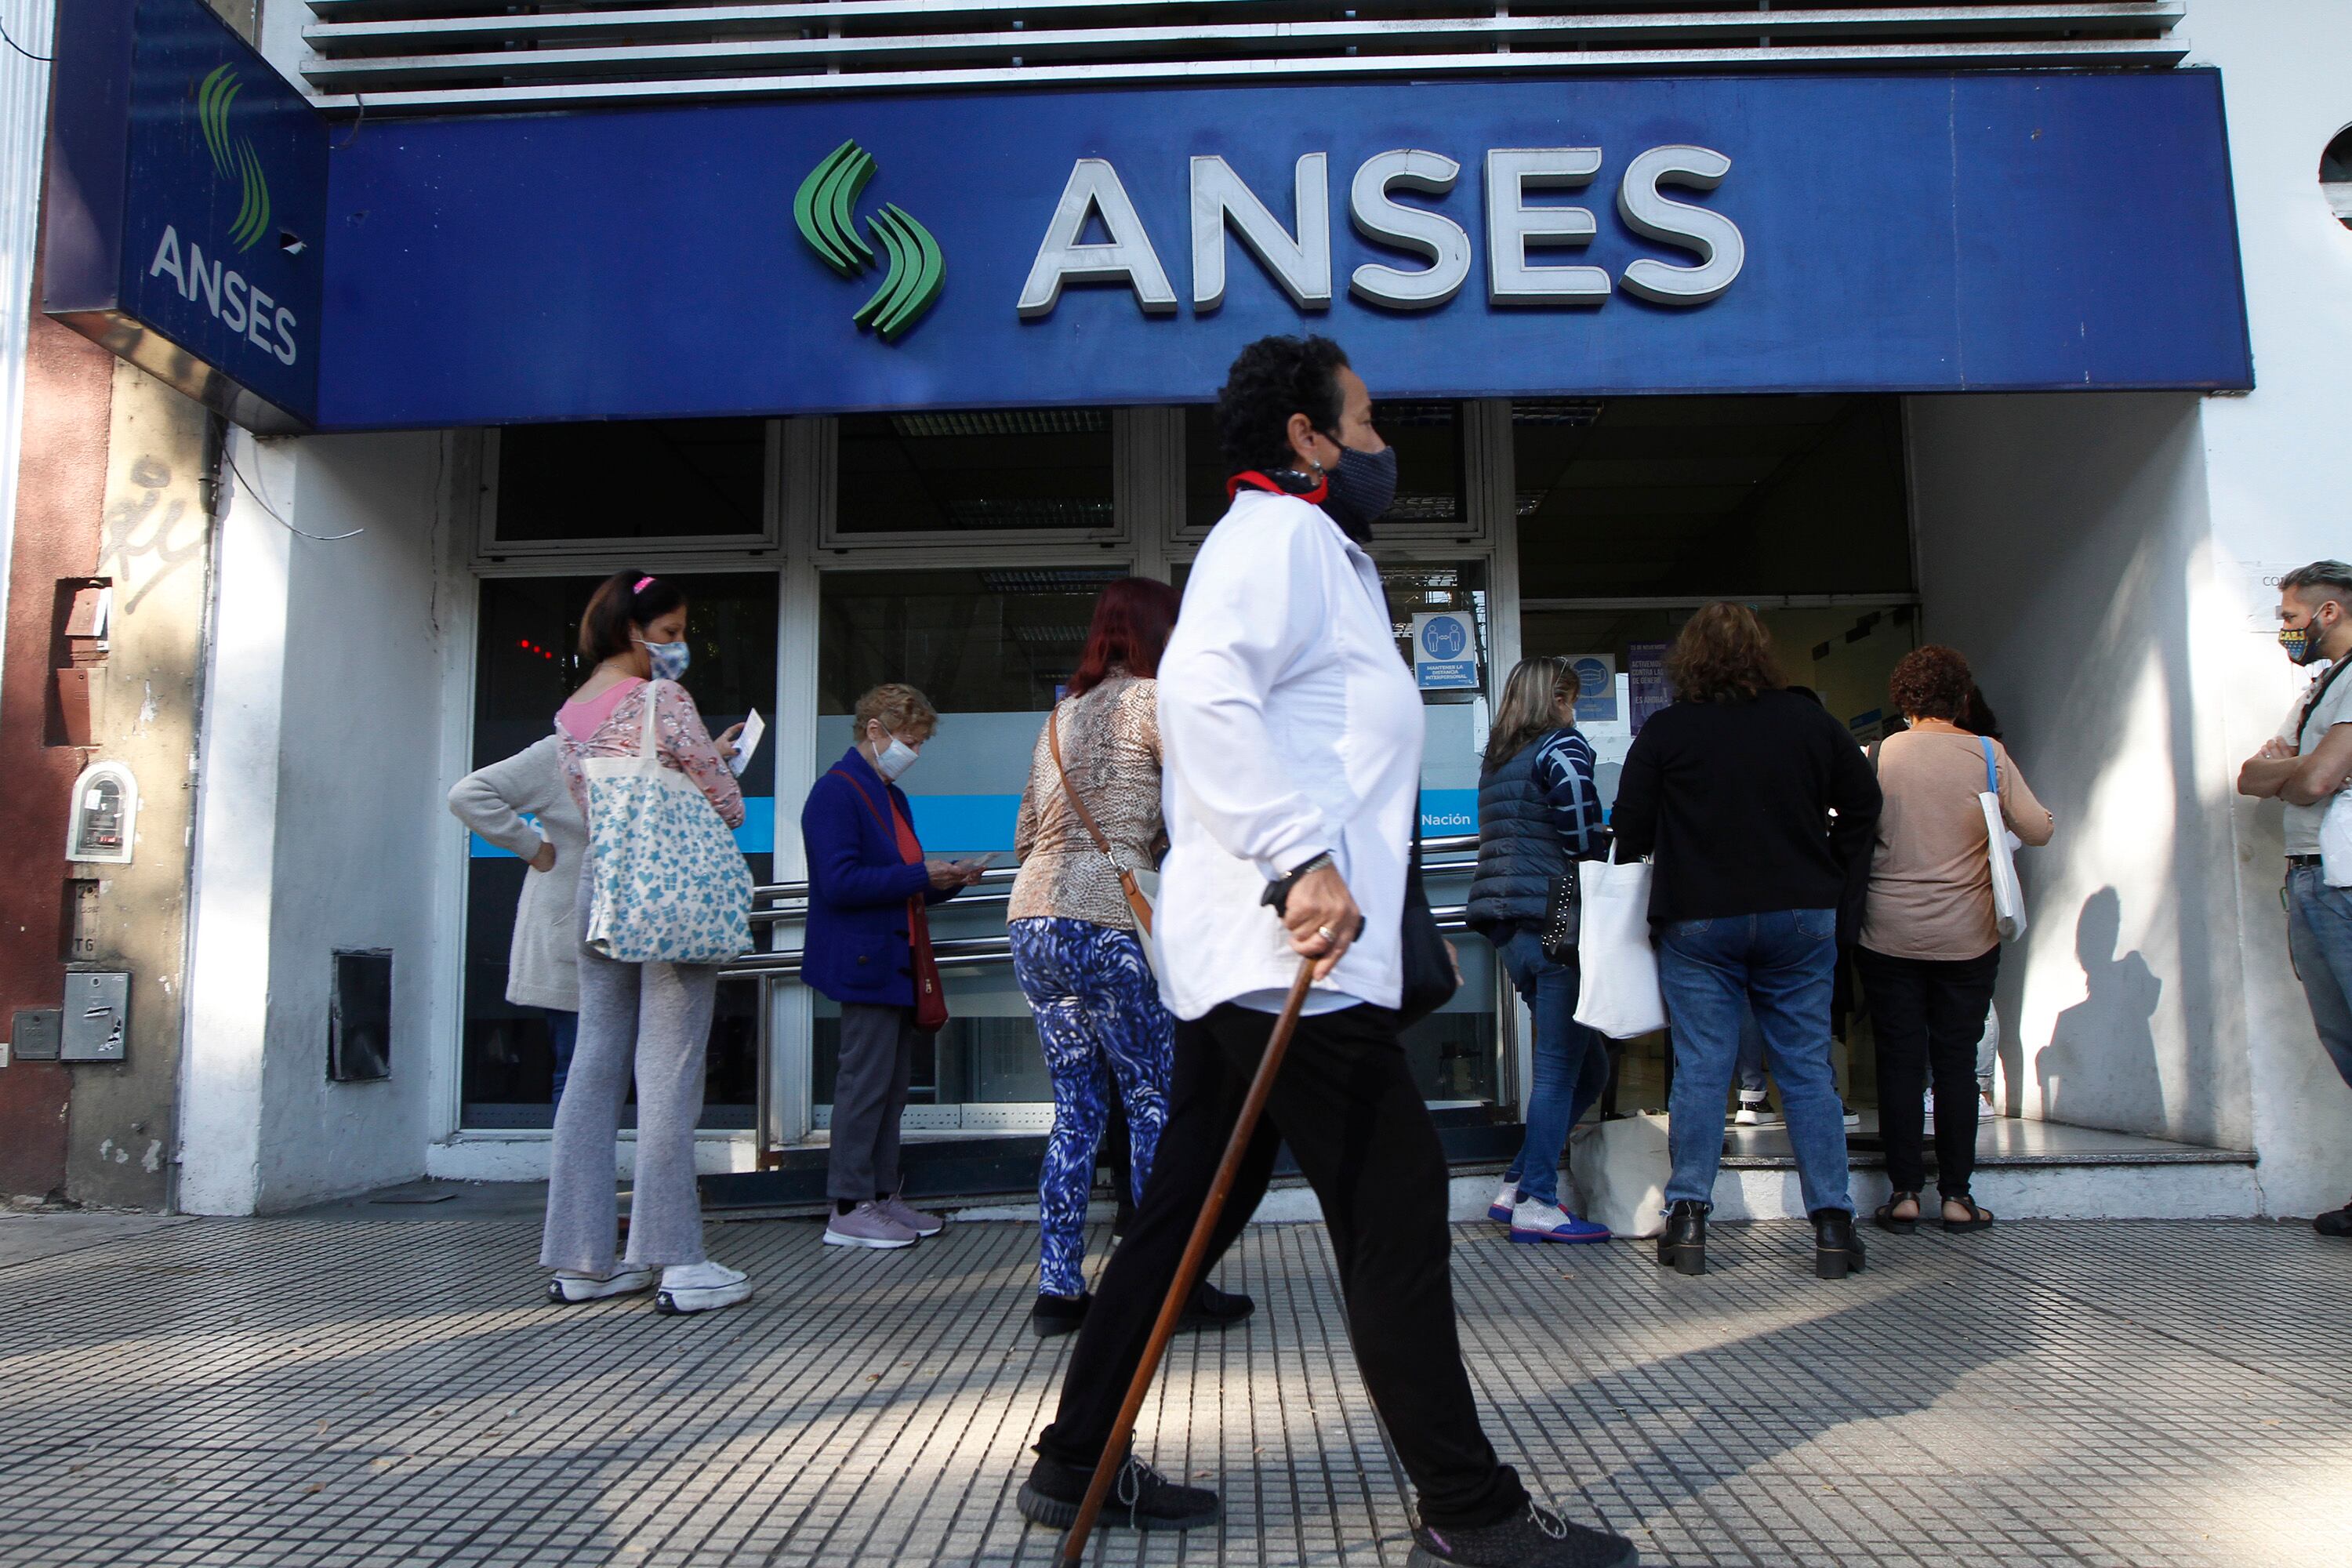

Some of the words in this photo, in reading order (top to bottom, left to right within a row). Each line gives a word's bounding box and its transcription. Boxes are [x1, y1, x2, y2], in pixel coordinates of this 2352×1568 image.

[150, 225, 296, 365] ANSES
[1017, 144, 1745, 314] ANSES
[1421, 813, 1471, 826] Nación
